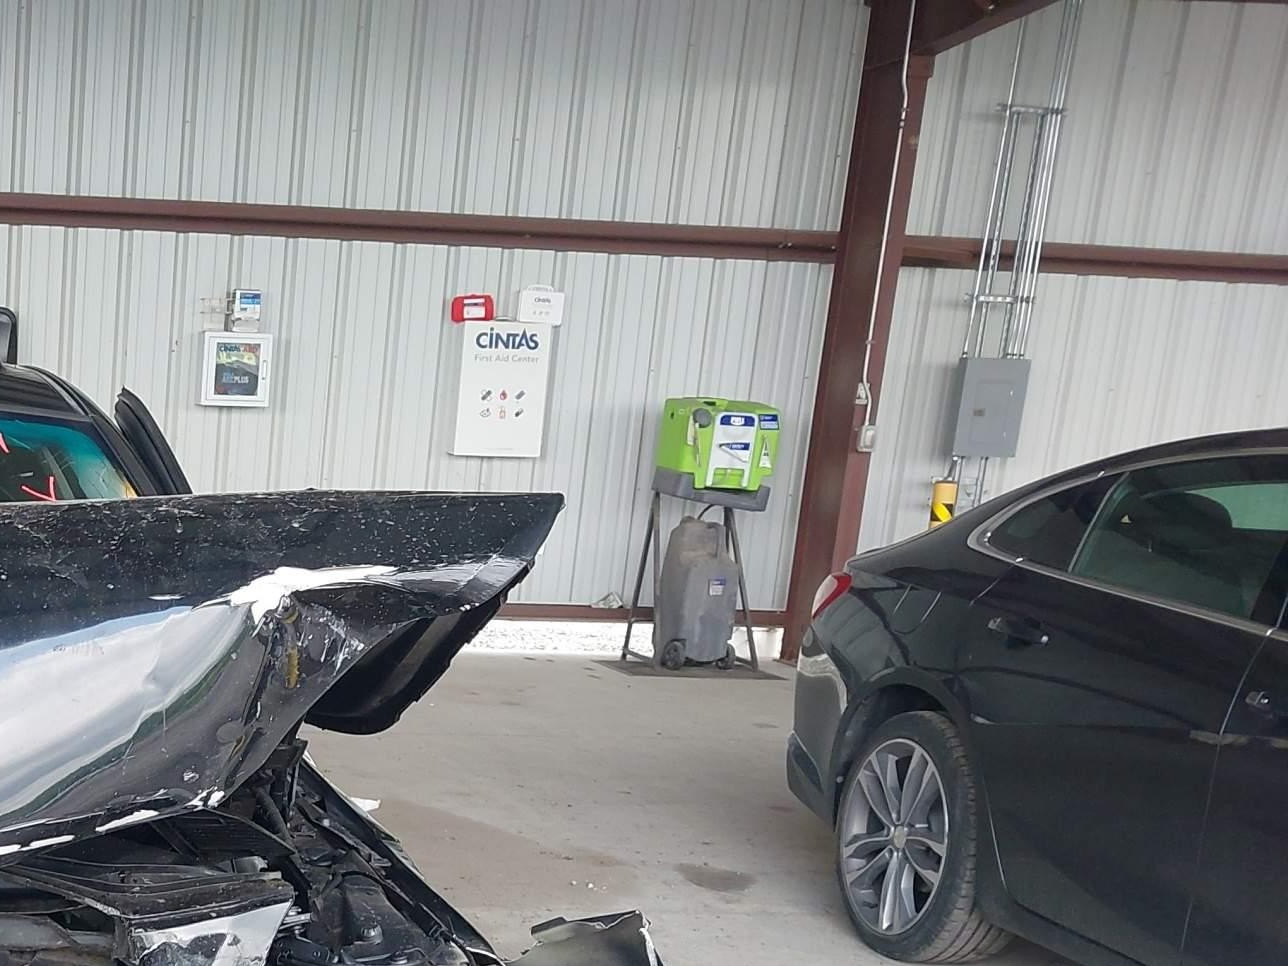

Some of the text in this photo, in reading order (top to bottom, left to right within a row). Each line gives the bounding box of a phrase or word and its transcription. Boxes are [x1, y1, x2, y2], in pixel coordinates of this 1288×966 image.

[475, 327, 540, 351] CINTAS
[474, 353, 540, 364] First Aid Center
